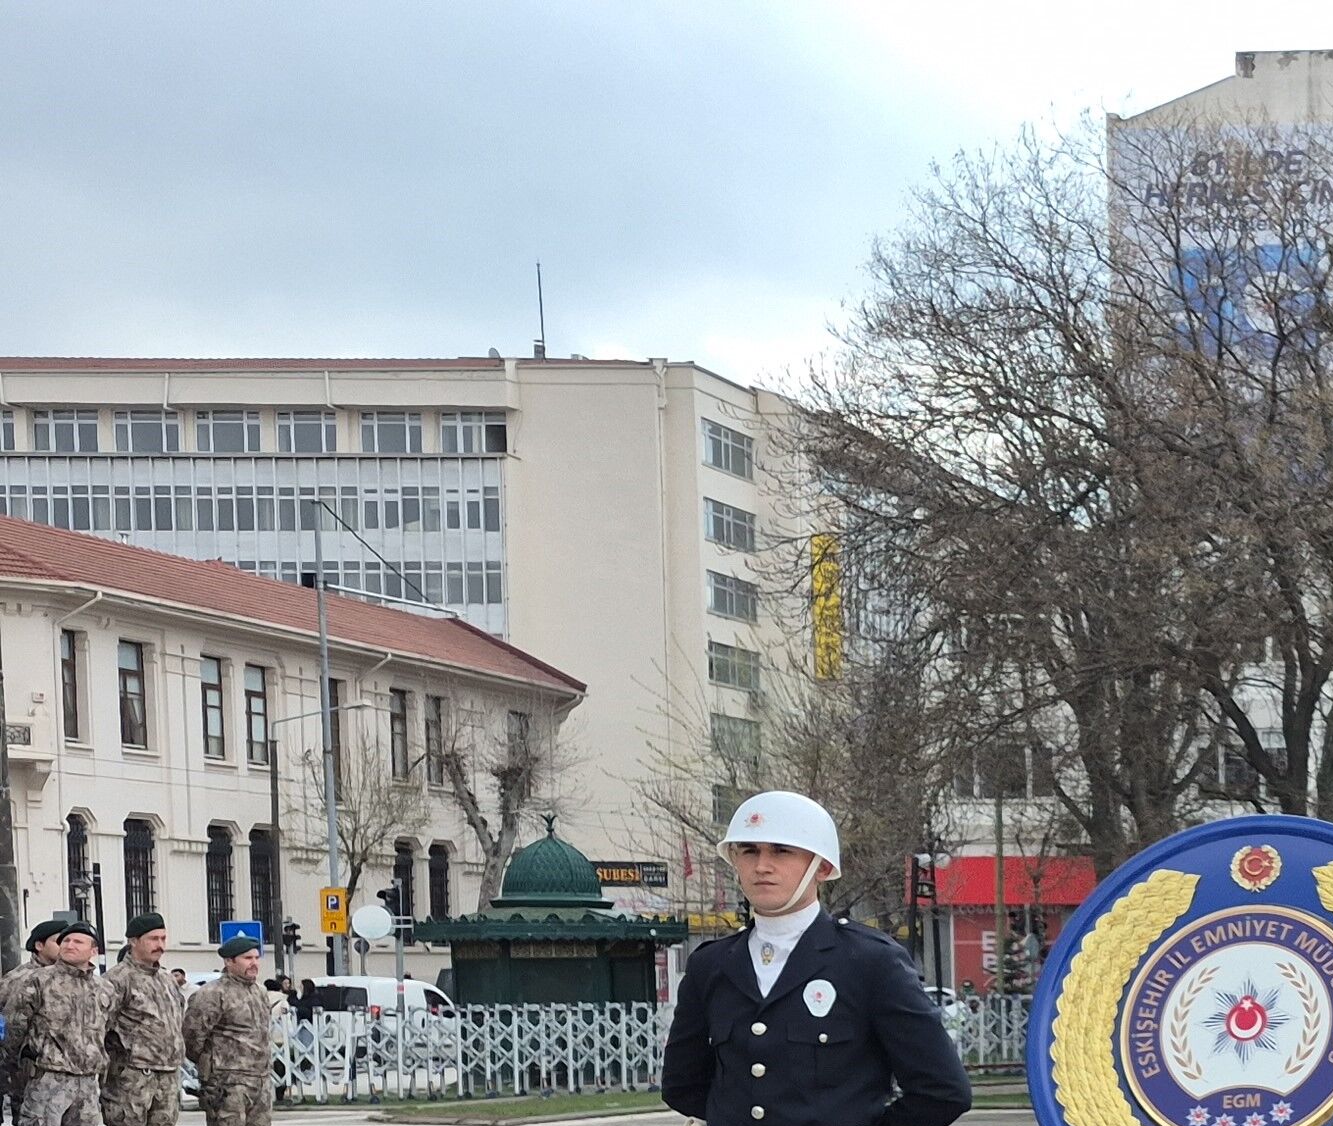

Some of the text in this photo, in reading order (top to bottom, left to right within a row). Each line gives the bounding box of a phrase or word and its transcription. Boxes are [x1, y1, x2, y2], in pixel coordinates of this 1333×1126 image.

[1131, 968, 1174, 1079] ESKİŞEHİR
[1190, 916, 1293, 954] EMNİYET
[1222, 1093, 1261, 1110] EGM
